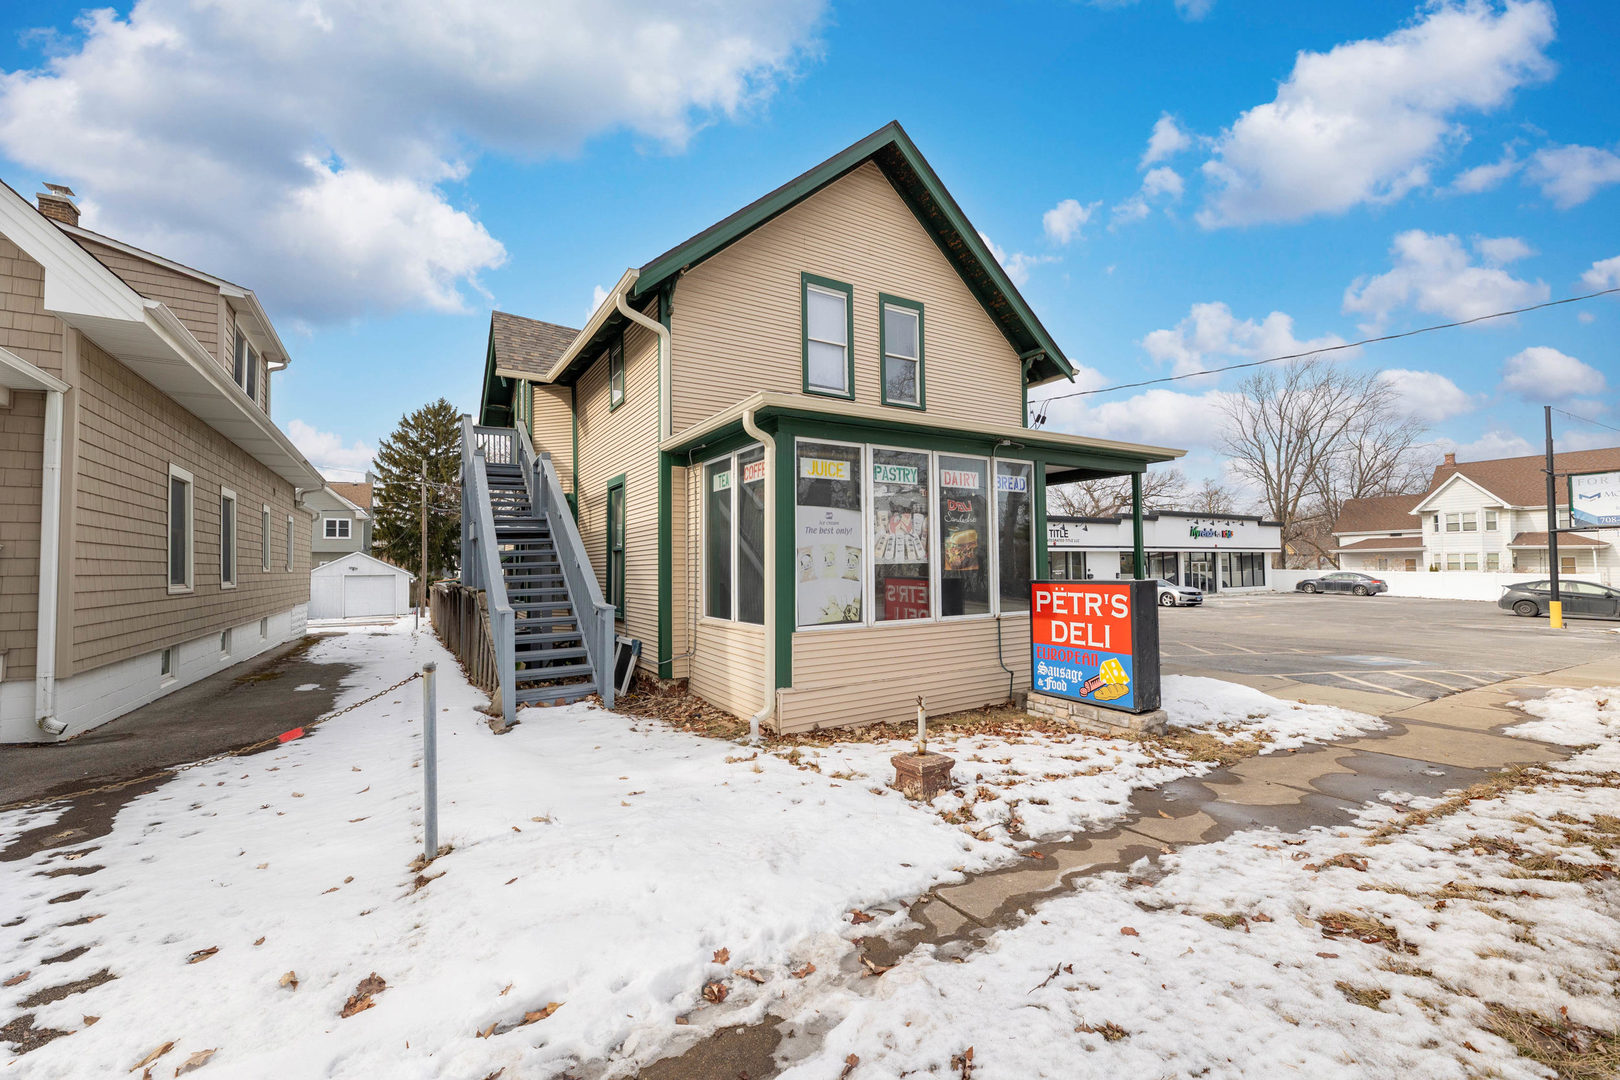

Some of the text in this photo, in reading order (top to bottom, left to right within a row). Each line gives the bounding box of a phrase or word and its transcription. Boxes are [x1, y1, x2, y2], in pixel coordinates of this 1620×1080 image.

[807, 459, 845, 478] JUICE
[874, 465, 918, 483] PASTRY
[718, 473, 730, 488] TEA
[943, 471, 977, 487] DAIRY
[997, 475, 1026, 491] BREAD
[1577, 476, 1609, 486] FOR
[805, 526, 853, 536] The best only!
[1049, 529, 1068, 538] TITLE
[1036, 587, 1128, 618] PËTR'S
[1051, 620, 1110, 648] DELI
[1036, 646, 1098, 667] EUROPEAN
[1037, 661, 1083, 683] Sausage
[1038, 677, 1067, 691] & Food
